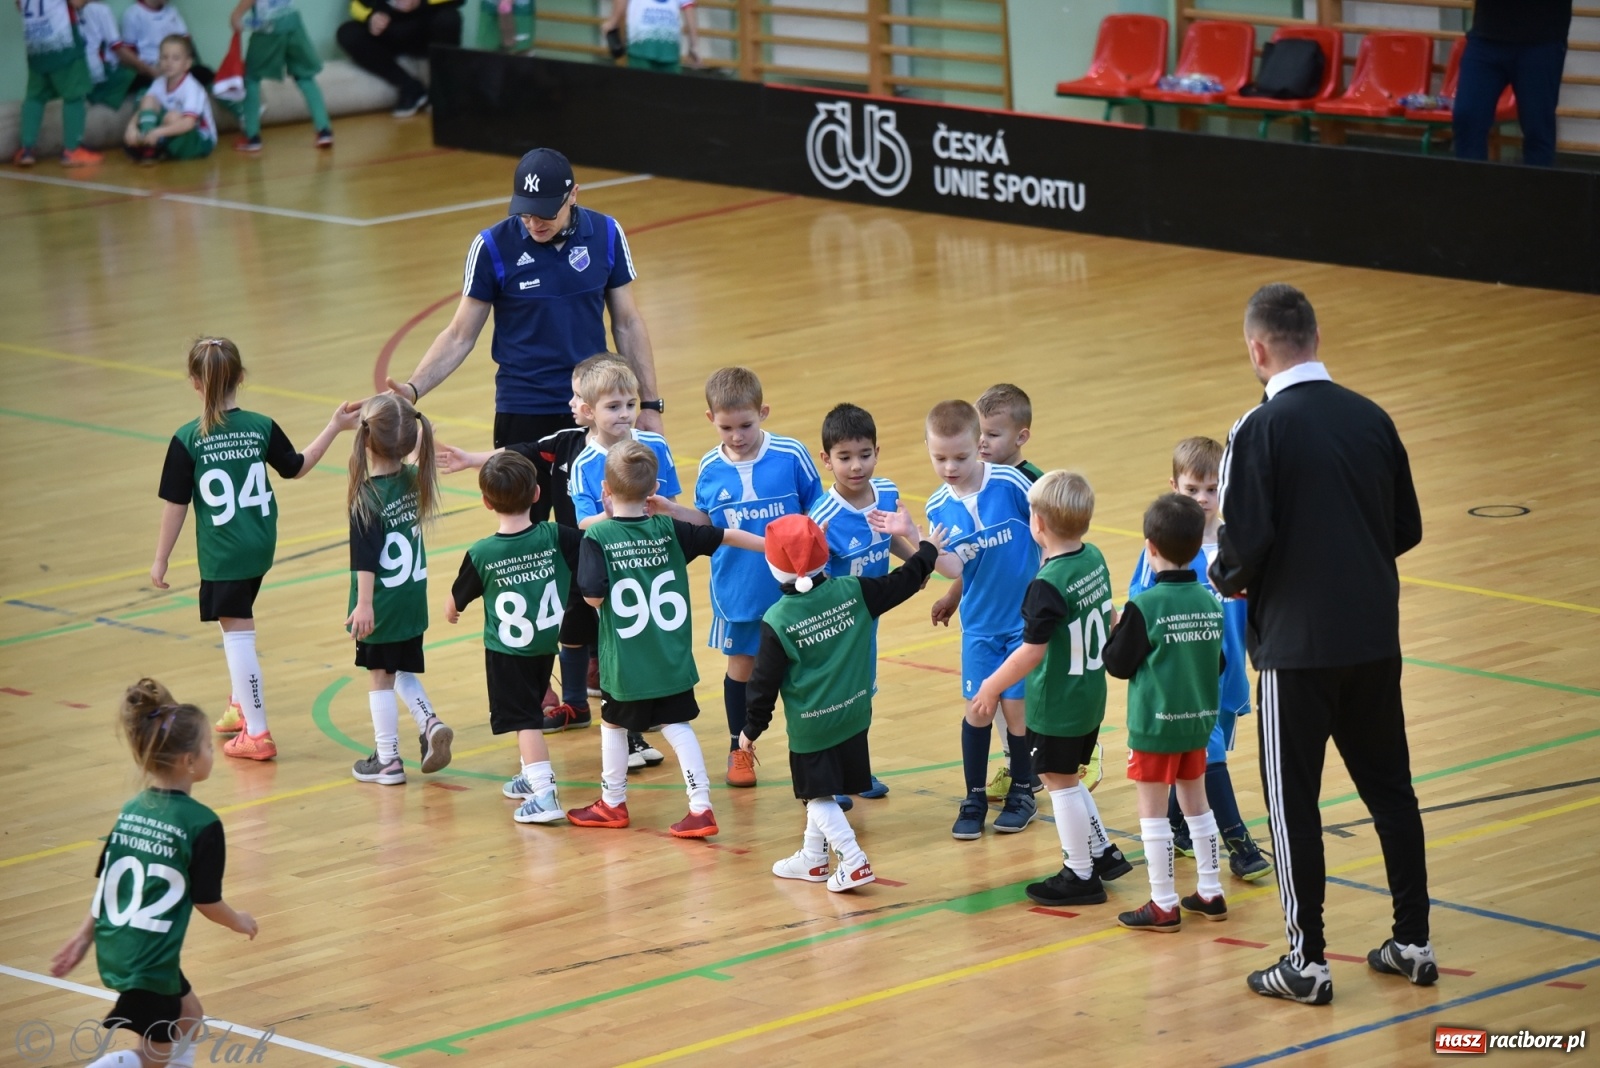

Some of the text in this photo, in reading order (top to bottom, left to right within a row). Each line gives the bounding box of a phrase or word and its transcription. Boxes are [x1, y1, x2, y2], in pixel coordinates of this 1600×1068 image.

[932, 122, 1010, 166] ČESKÁ
[523, 173, 541, 192] NY
[933, 165, 1087, 212] UNIE SPORTU
[194, 433, 229, 448] AKADEMIA
[200, 446, 262, 465] TWORKÓW
[199, 461, 272, 526] 94
[723, 502, 785, 529] Betonlit
[604, 540, 637, 551] KADEMIA
[485, 556, 521, 571] AKADEMIA
[496, 563, 532, 576] MŁODEGO
[610, 553, 670, 572] TWORKÓW
[494, 565, 556, 587] TWORKÓW
[495, 579, 565, 648] 84
[611, 570, 688, 639] 96
[785, 598, 858, 633] AKADEMIA PIŁKARSKA
[796, 616, 856, 648] TWORKÓW
[798, 618, 833, 637] MŁODEGO
[1163, 628, 1222, 644] TWORKÓW
[966, 680, 972, 692] 3
[111, 831, 178, 859] TWORKÓW
[91, 851, 187, 933] 102
